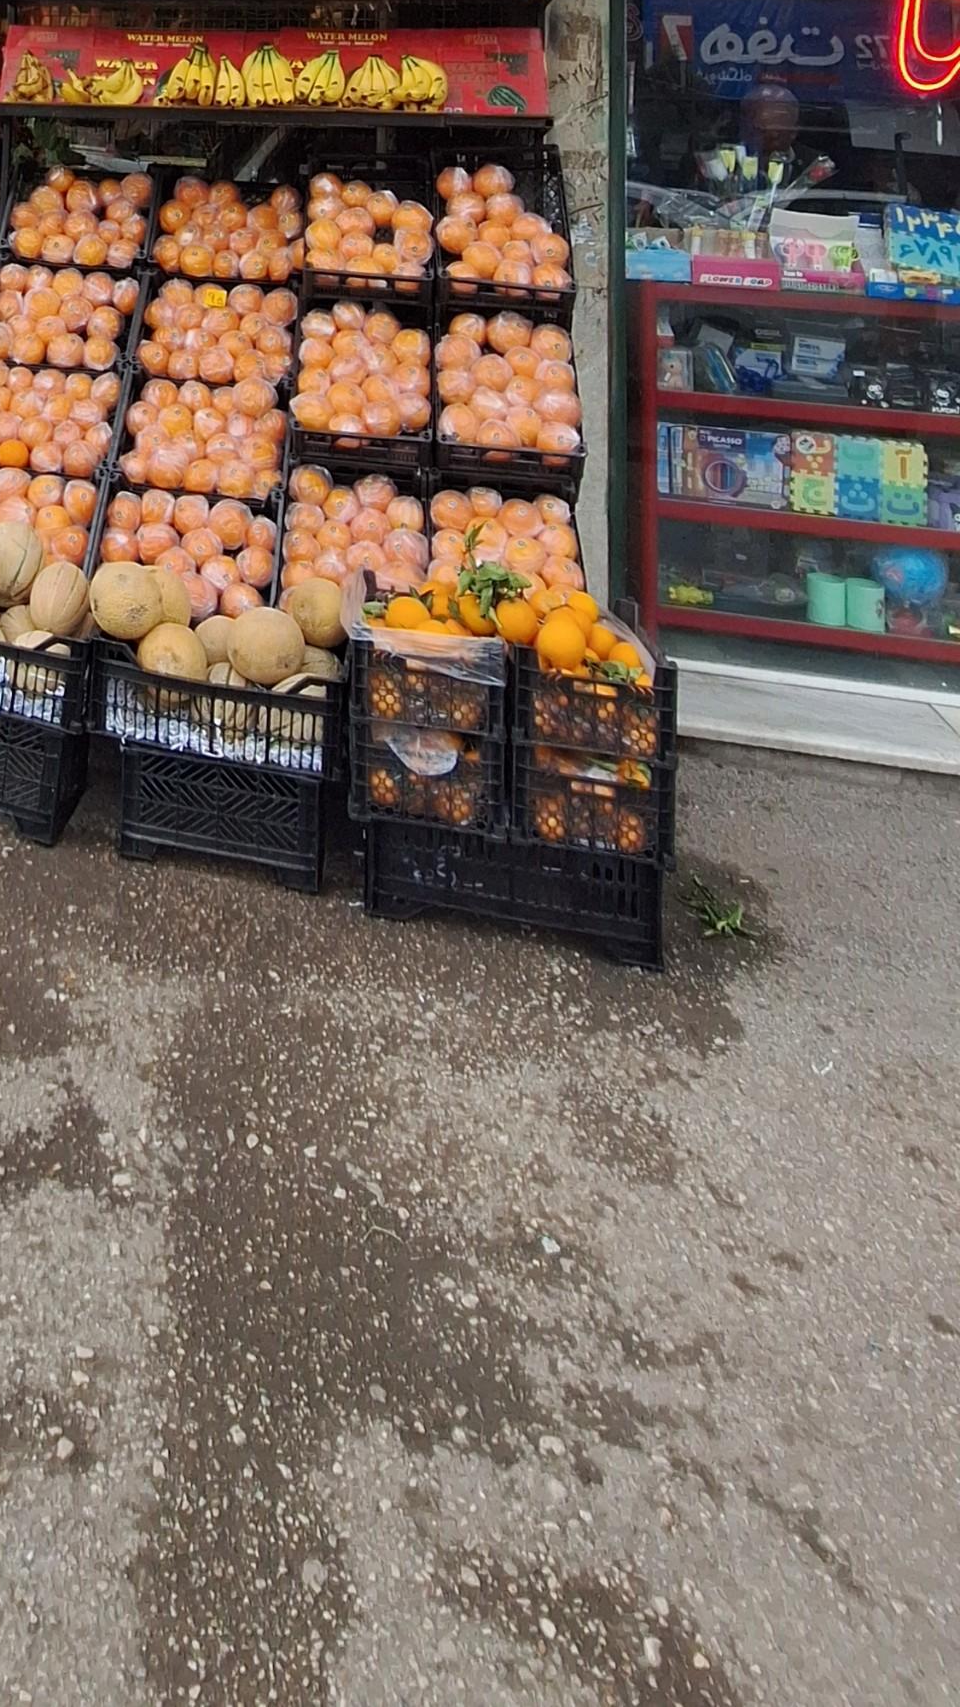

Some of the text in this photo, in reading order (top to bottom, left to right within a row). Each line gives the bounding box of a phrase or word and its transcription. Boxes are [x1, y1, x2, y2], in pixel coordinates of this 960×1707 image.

[127, 34, 204, 43] WATER MELON
[306, 32, 388, 42] WATER MELON
[96, 59, 159, 71] WAER
[707, 435, 743, 445] PICASSO
